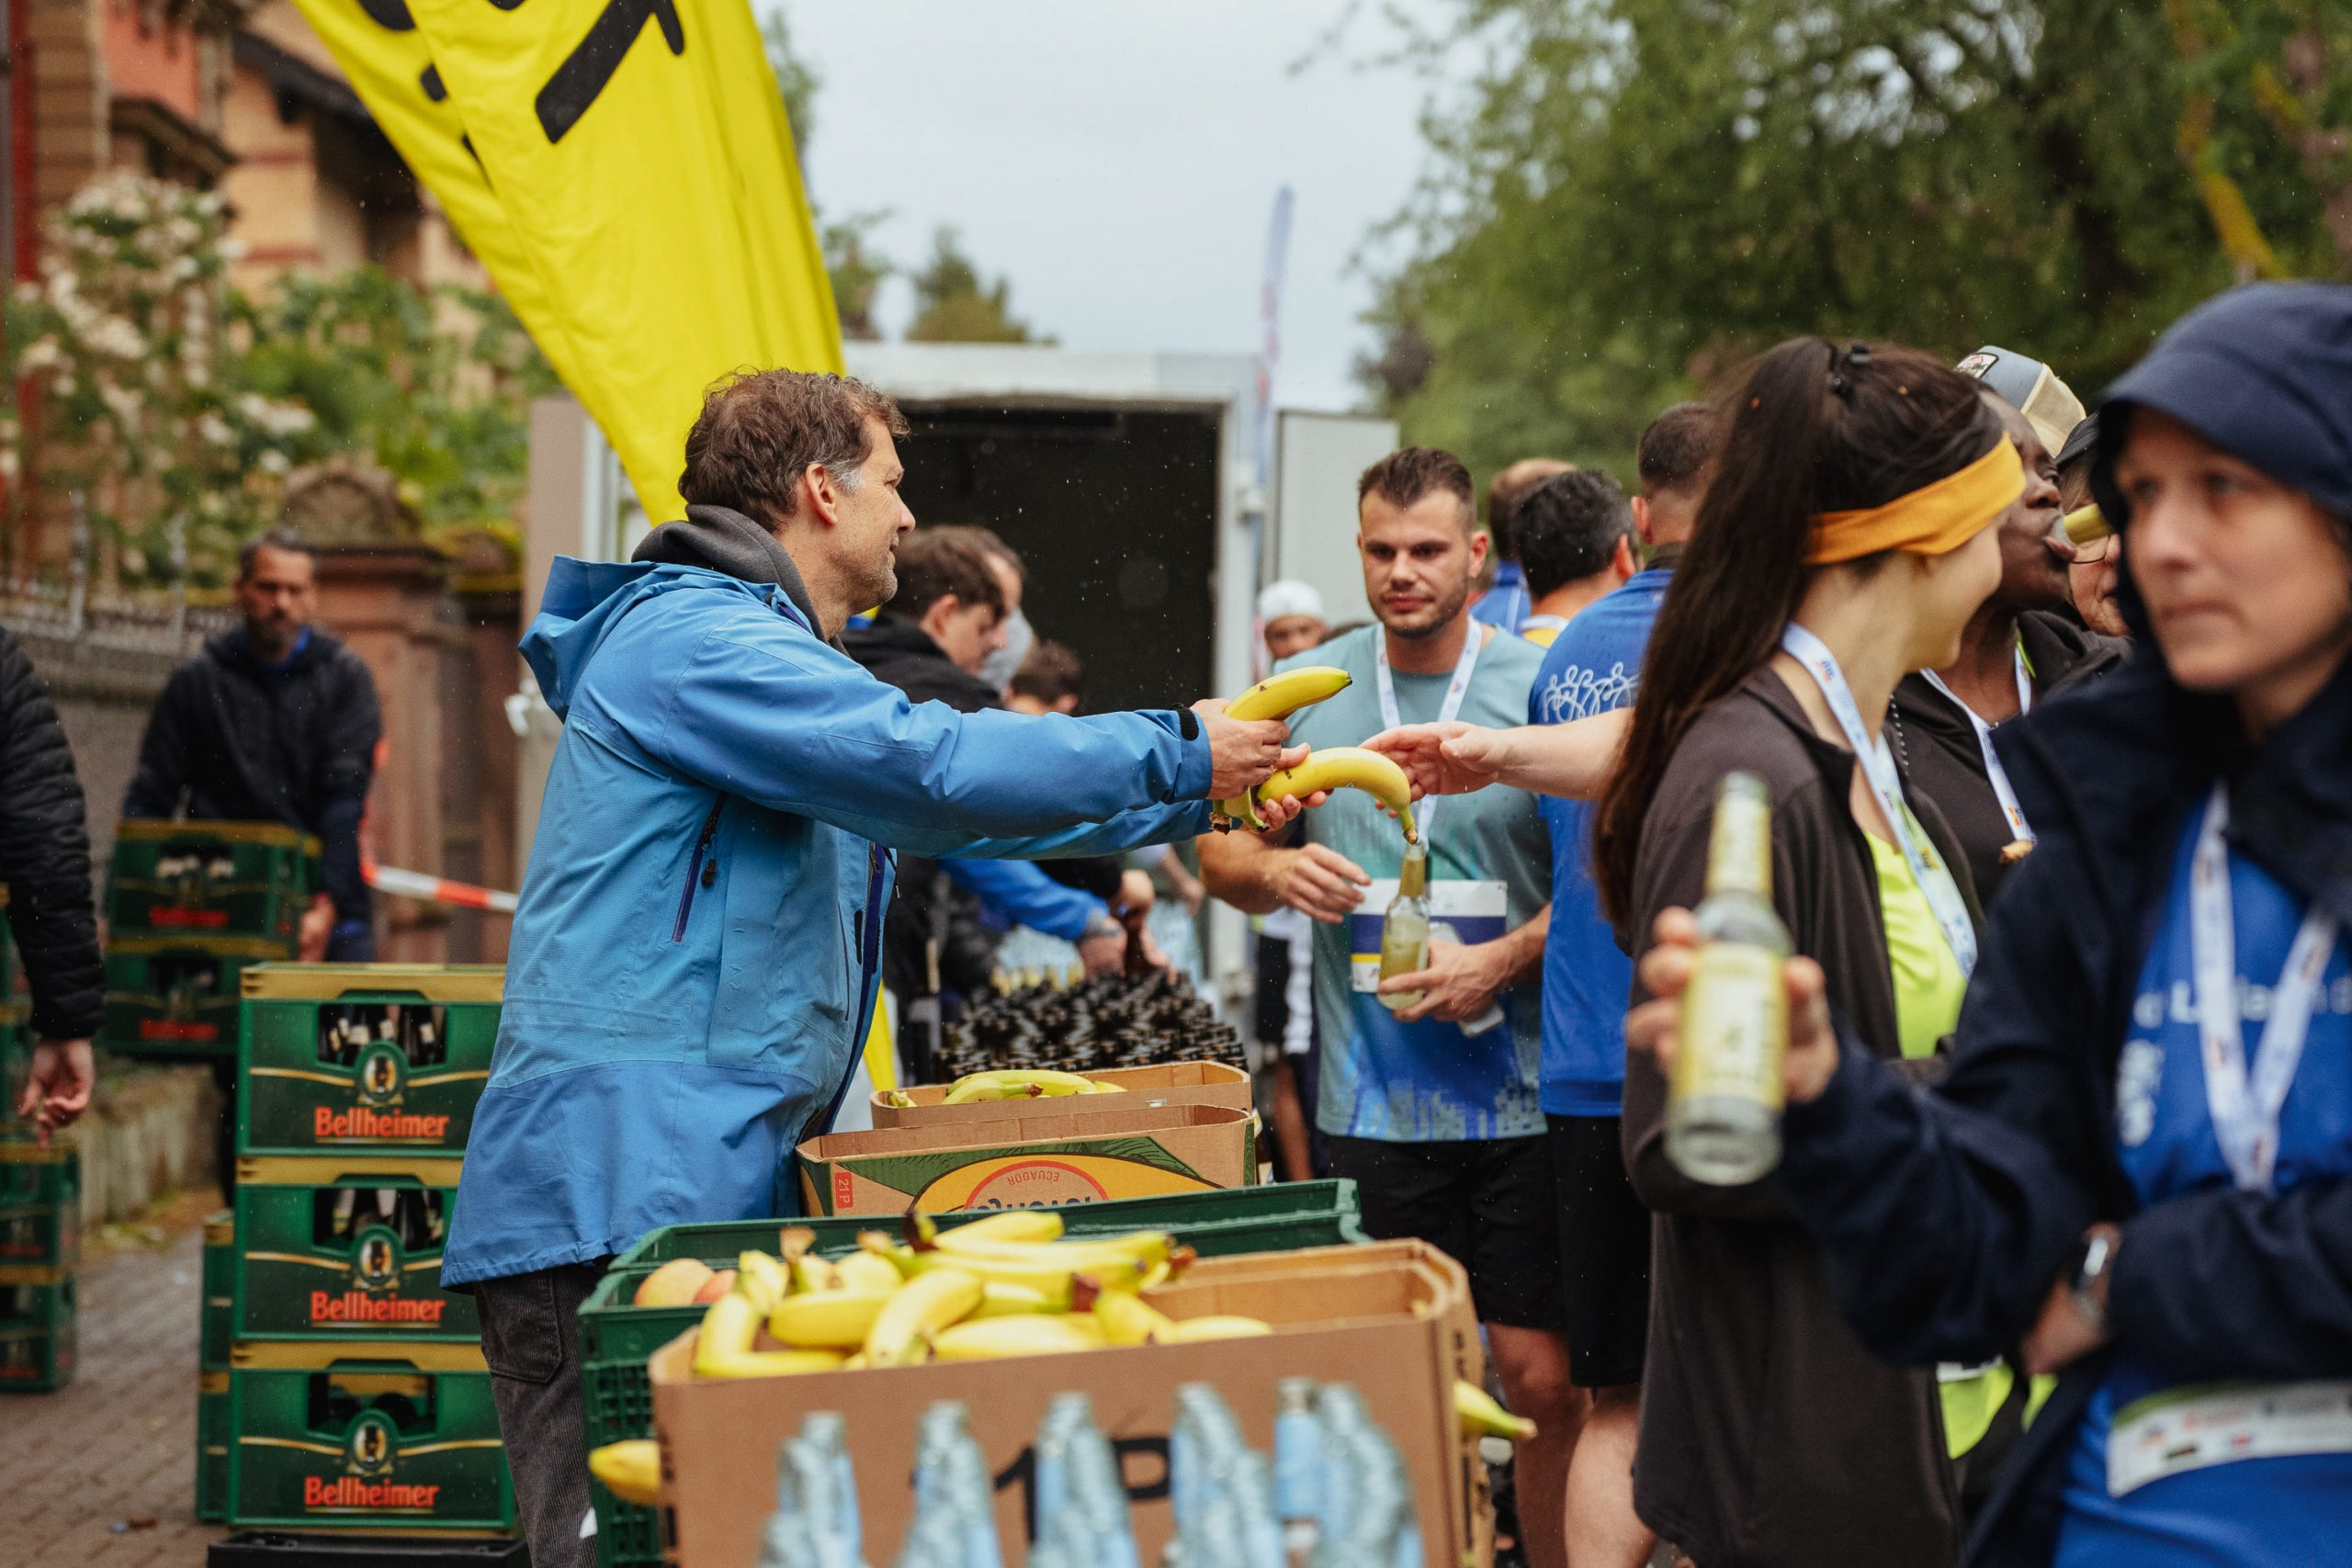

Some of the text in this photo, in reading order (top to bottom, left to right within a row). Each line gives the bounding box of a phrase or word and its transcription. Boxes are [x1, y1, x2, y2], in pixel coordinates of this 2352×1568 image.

[314, 1106, 450, 1137] Bellheimer
[838, 1179, 851, 1203] 21 P
[1007, 1170, 1060, 1186] ECUADOR
[311, 1290, 447, 1321] Bellheimer
[304, 1475, 440, 1506] Bellheimer
